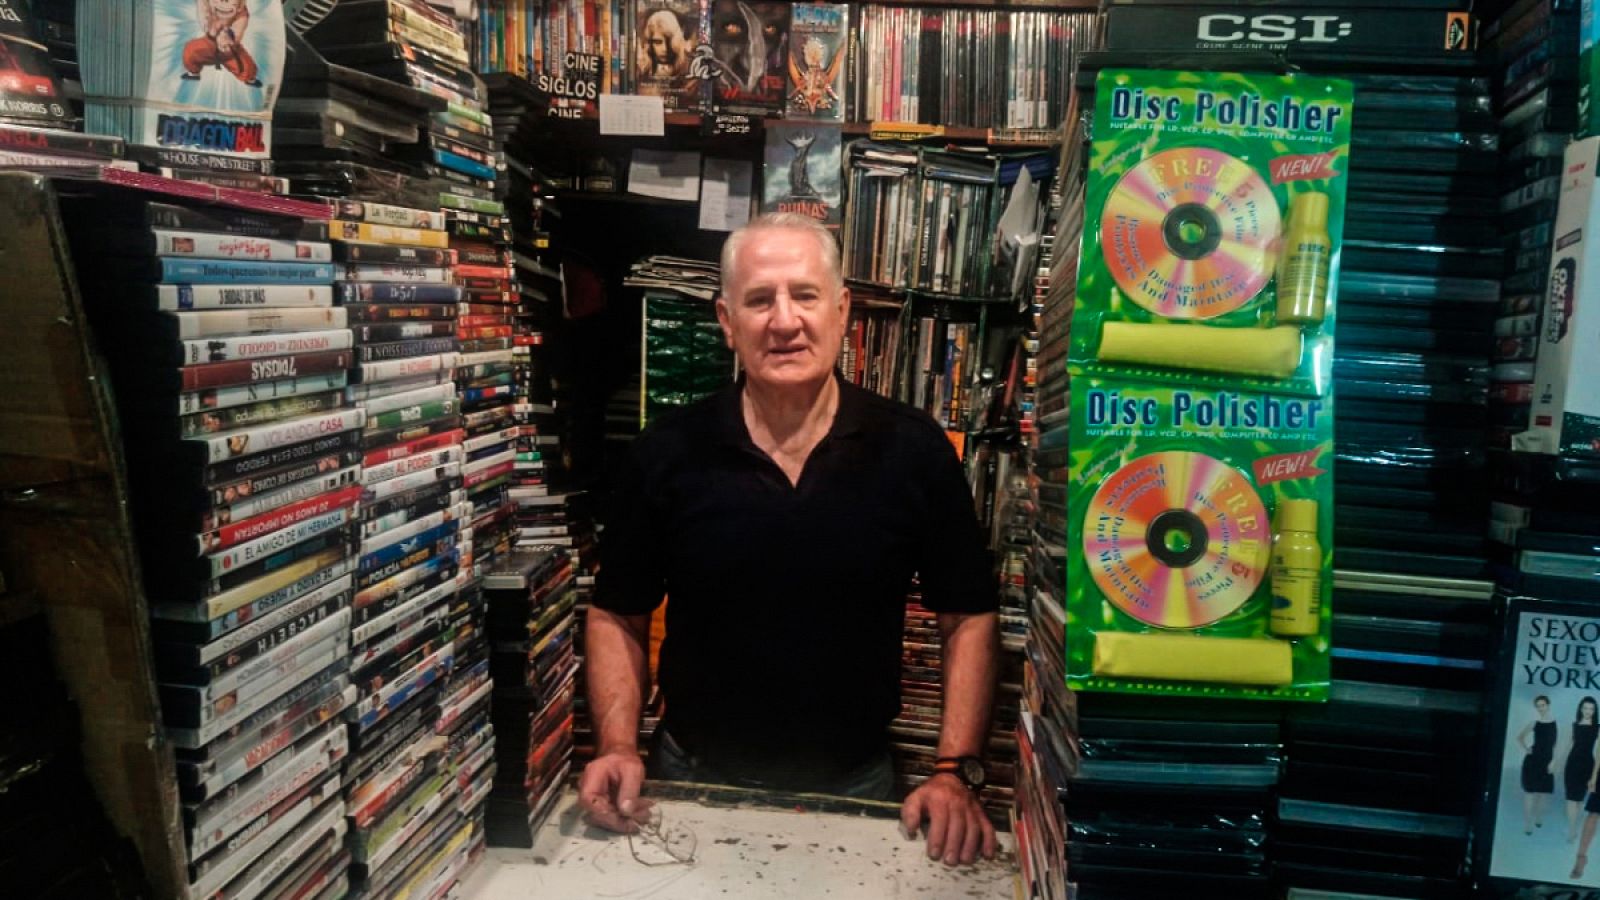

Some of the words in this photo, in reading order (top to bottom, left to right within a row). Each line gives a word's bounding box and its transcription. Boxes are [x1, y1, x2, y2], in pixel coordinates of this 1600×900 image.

[566, 52, 599, 73] CINE
[538, 75, 597, 99] SIGLOS
[1111, 87, 1181, 121] Disc
[1194, 91, 1342, 133] Polisher
[1152, 157, 1233, 187] FREE
[1235, 182, 1255, 199] 5
[1276, 155, 1323, 179] NEW!
[1087, 389, 1158, 427] Disc
[1172, 390, 1324, 431] Polisher
[319, 416, 345, 432] CASA
[1261, 455, 1308, 480] NEW!
[1211, 474, 1260, 562] FREE
[245, 546, 255, 561] EL
[255, 534, 285, 555] AMIGO
[284, 530, 296, 544] DE
[305, 511, 341, 533] HERMANA
[1231, 561, 1252, 580] 5
[1529, 617, 1600, 642] SEXO
[1523, 664, 1600, 690] YORK
